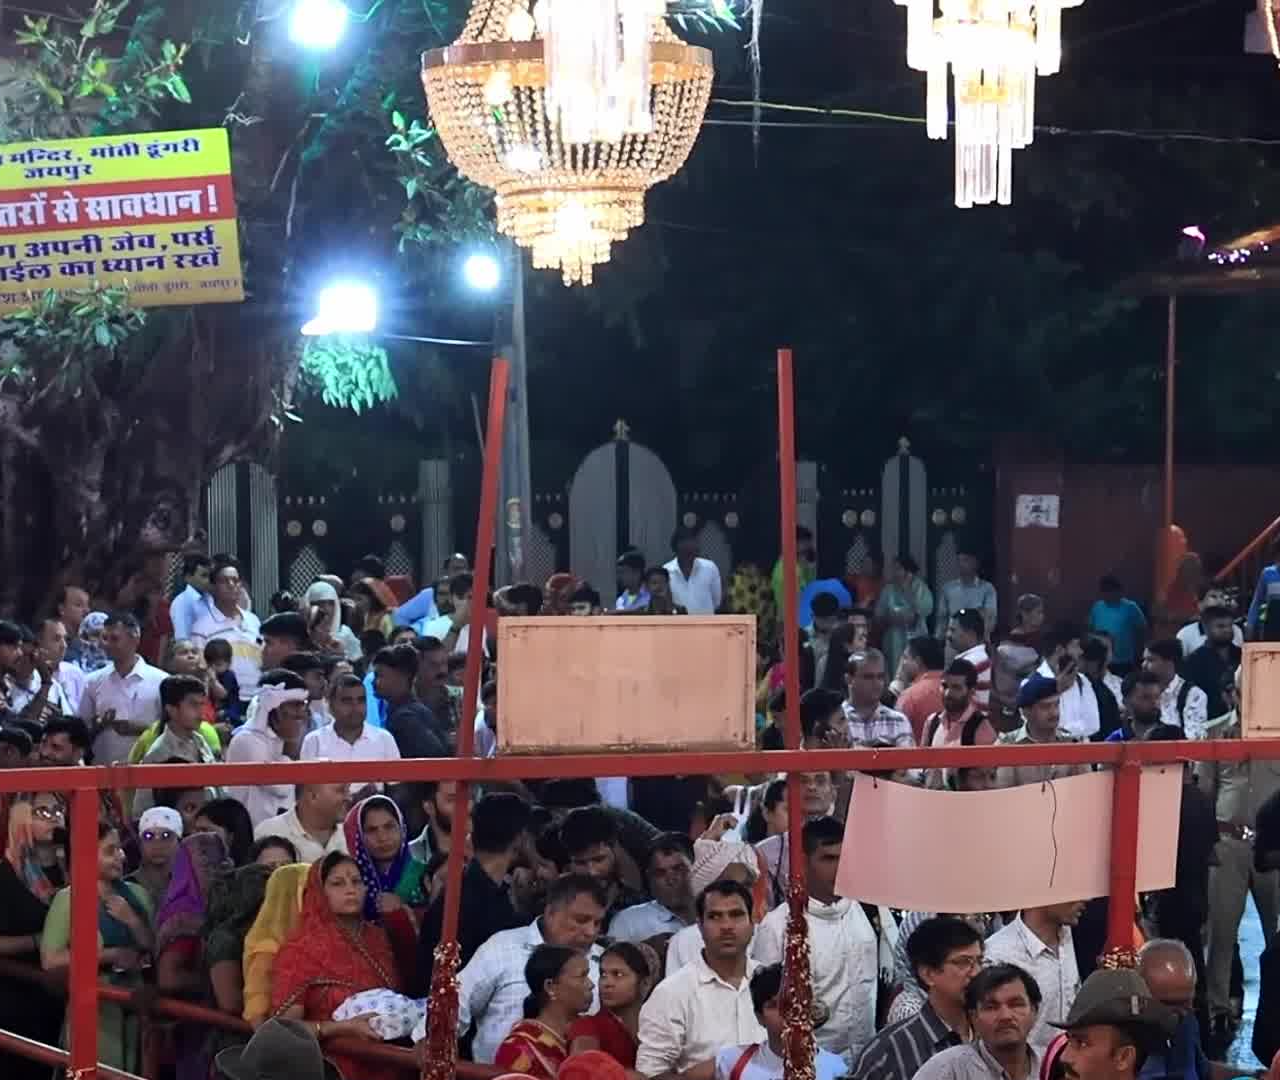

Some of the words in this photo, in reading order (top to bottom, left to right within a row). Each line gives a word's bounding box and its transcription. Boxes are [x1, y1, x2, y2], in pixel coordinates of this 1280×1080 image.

[24, 163, 93, 181] जयपुर
[52, 190, 79, 224] से
[24, 234, 103, 258] अपनी
[57, 259, 96, 277] का
